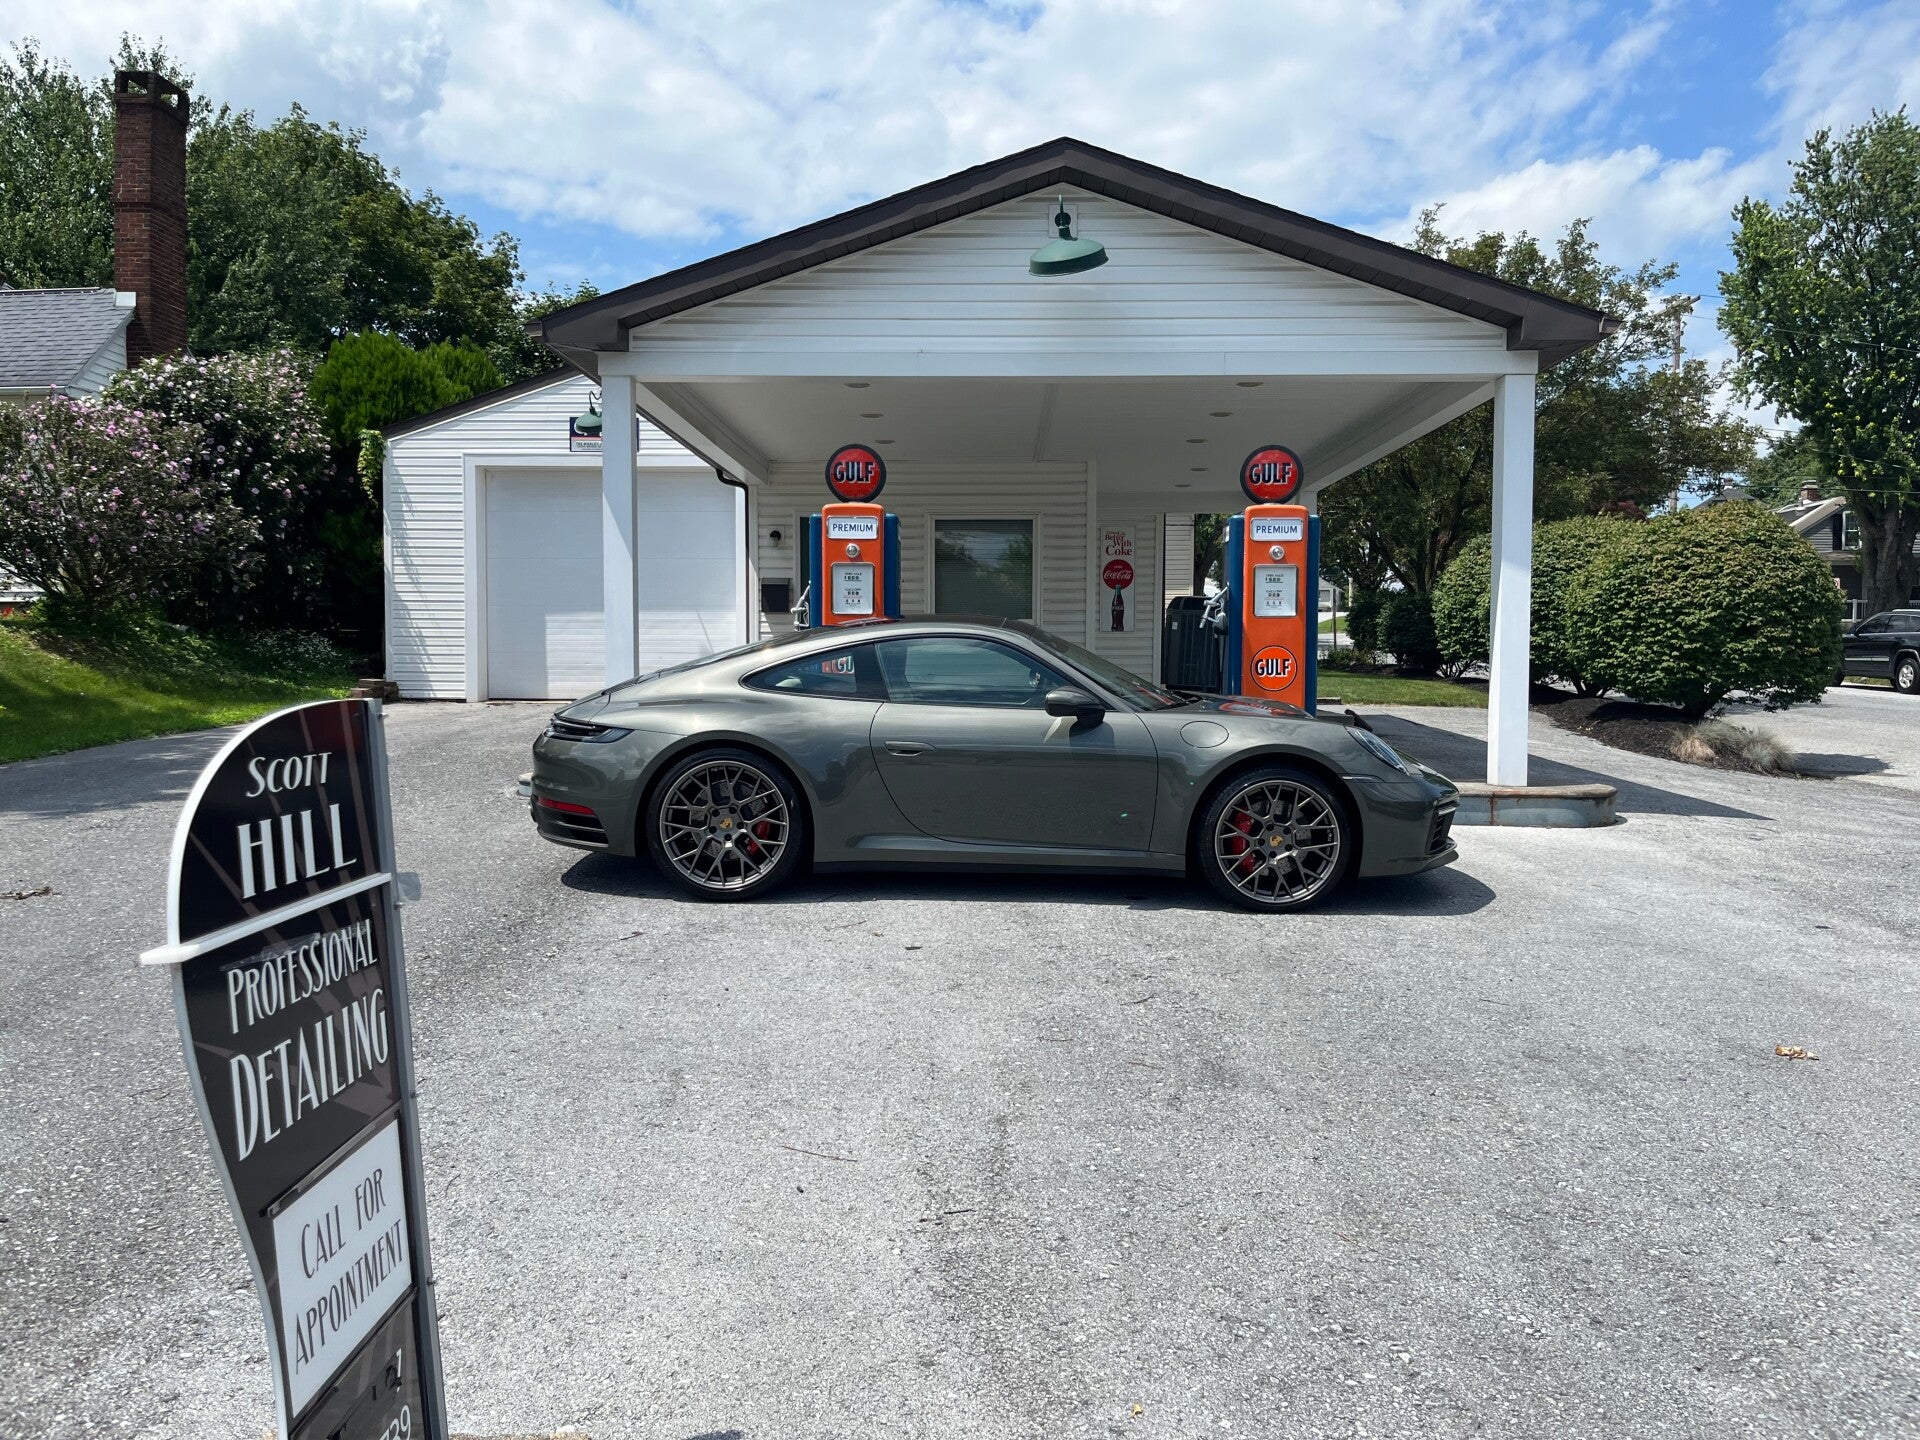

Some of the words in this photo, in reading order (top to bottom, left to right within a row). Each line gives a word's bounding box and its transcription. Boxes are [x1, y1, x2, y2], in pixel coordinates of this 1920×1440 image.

[834, 461, 875, 484] GULF
[1249, 462, 1292, 485] GULF
[832, 523, 874, 532] PREMIUM
[1256, 525, 1298, 534] PREMIUM
[1105, 545, 1133, 556] Coke
[1255, 658, 1291, 677] GULF
[246, 752, 332, 797] SCOTT
[237, 803, 357, 899] HILL
[226, 918, 378, 1034] PROFESSIONAL
[230, 988, 389, 1162] DETAILING
[301, 1204, 346, 1279] CALL
[355, 1167, 386, 1231] FOR
[295, 1218, 404, 1375] APPOINTMENT
